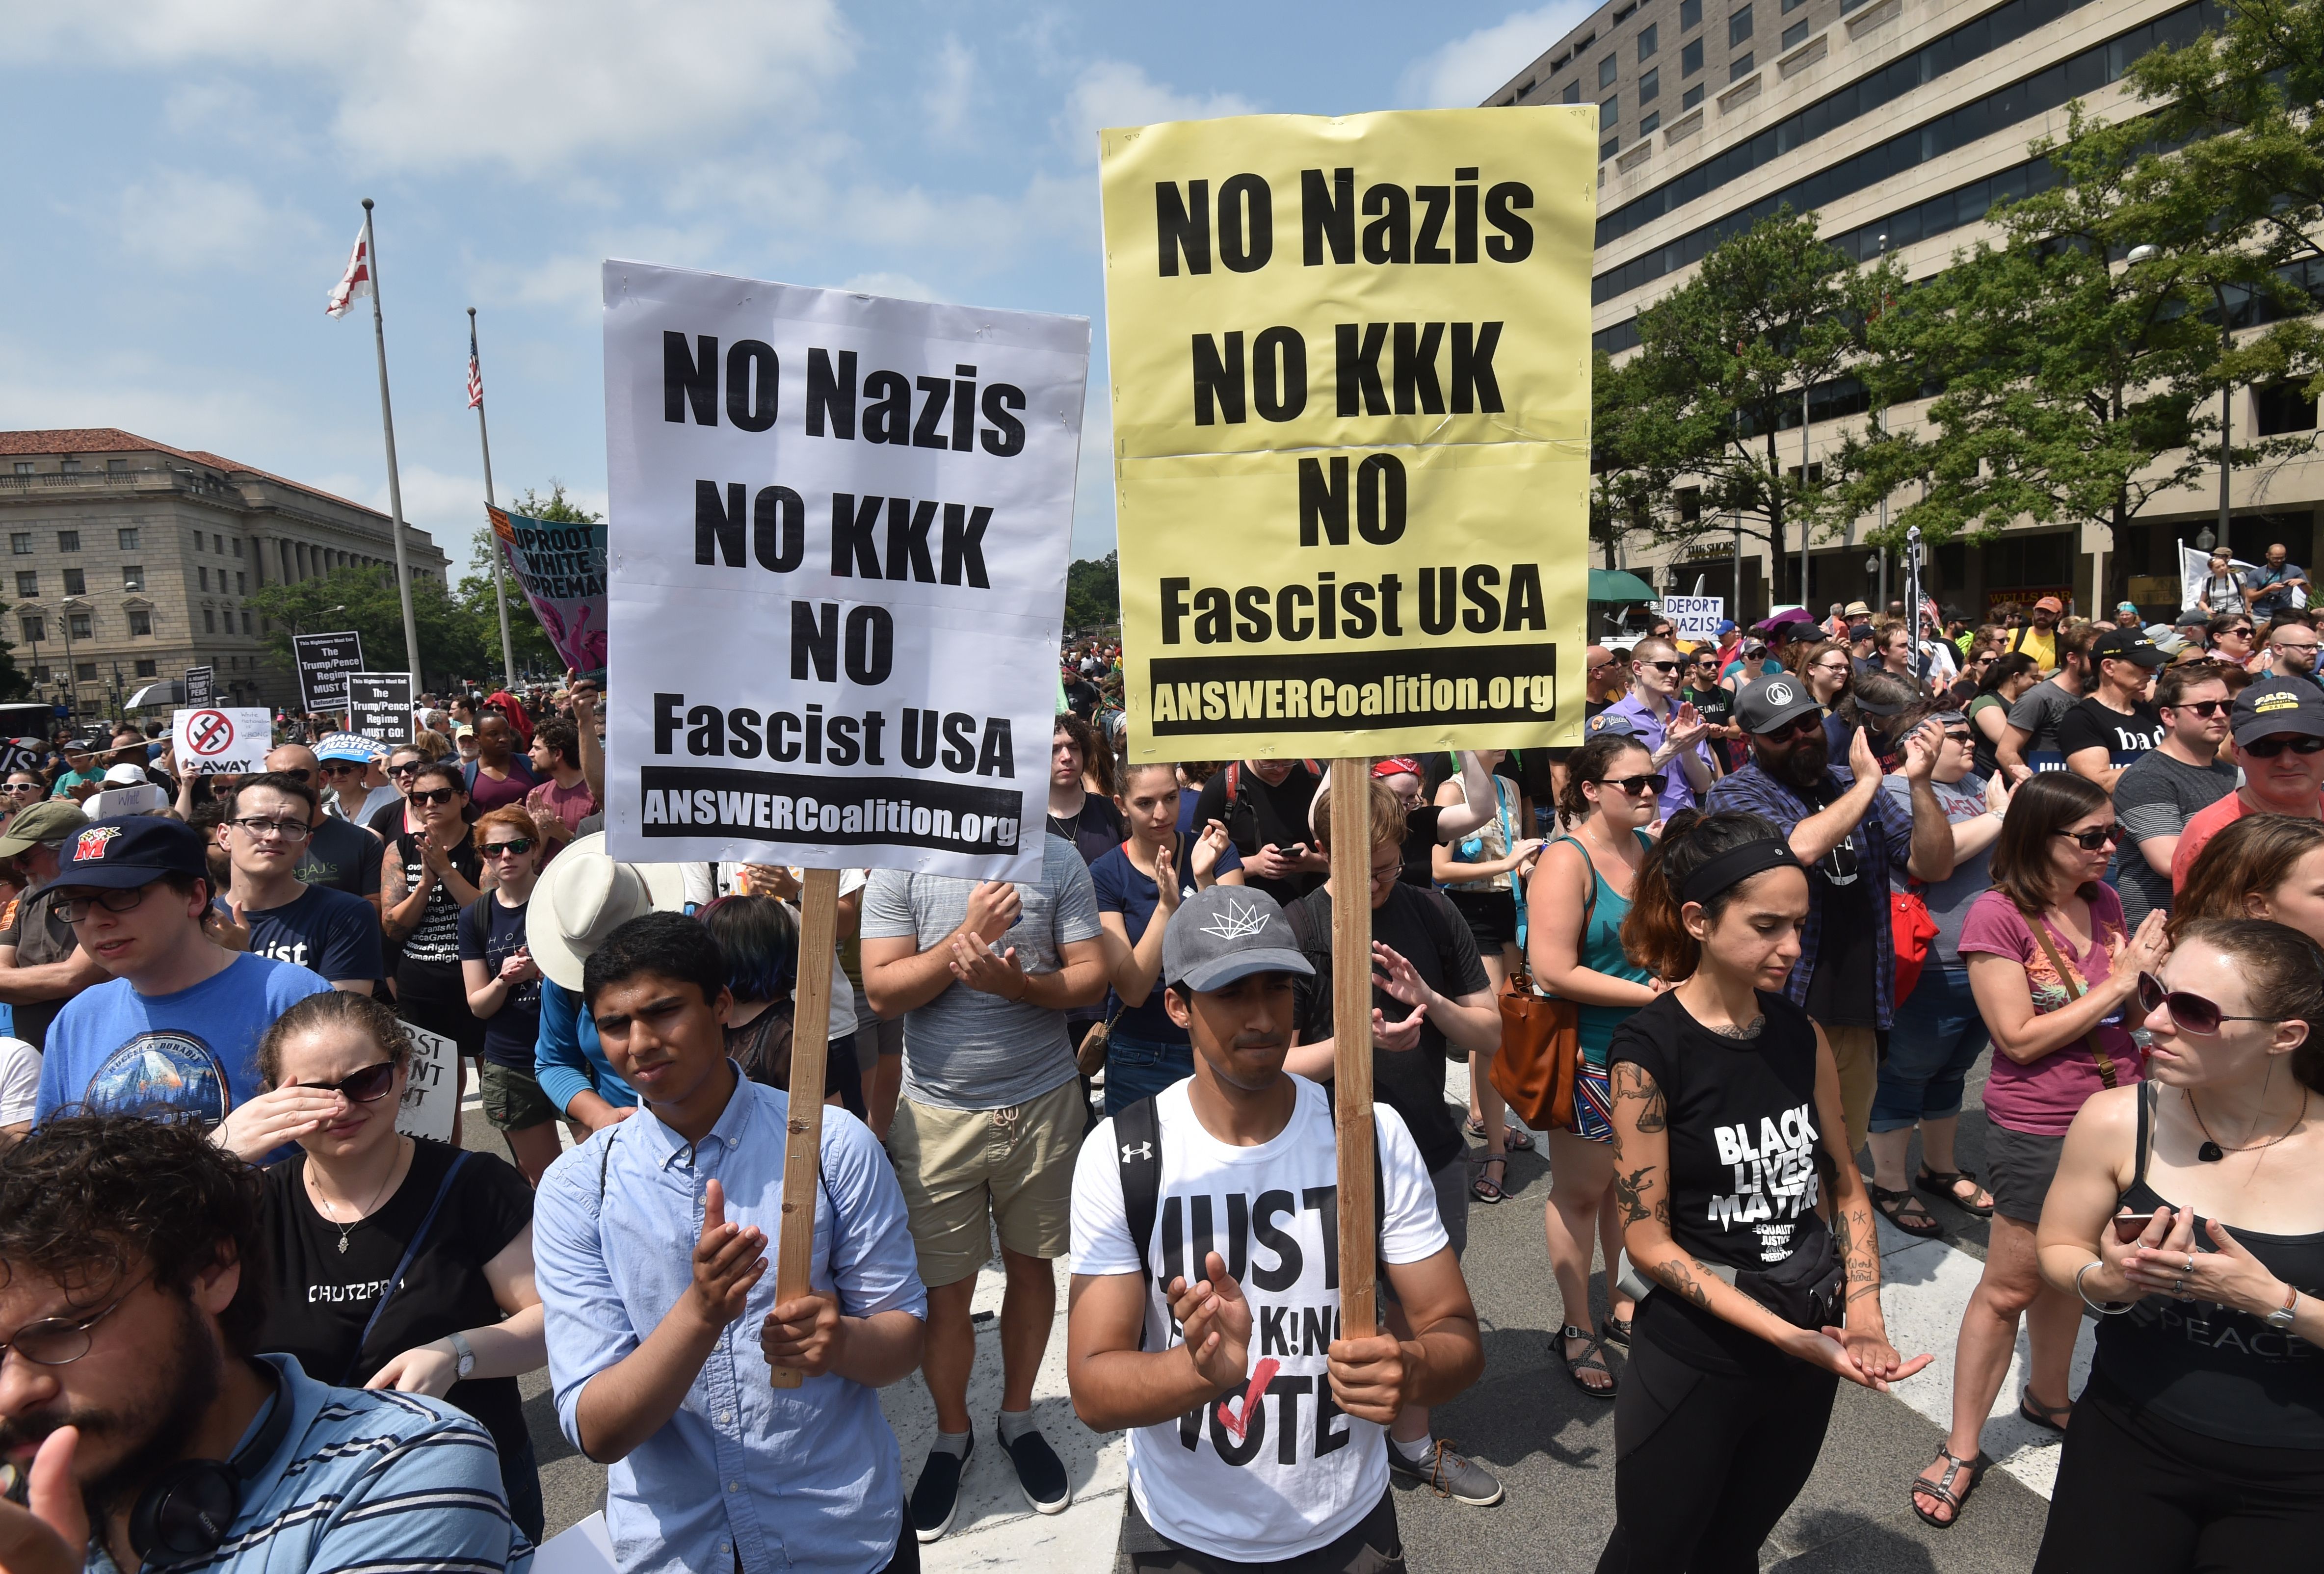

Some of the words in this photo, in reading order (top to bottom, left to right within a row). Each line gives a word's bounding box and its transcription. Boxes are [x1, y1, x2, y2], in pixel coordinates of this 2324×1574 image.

[1156, 173, 1273, 277] NO
[1301, 167, 1534, 266] Nazis
[1191, 326, 1307, 426] NO
[1335, 321, 1505, 418] KKK
[663, 330, 780, 432] NO
[805, 347, 1027, 457] Nazis
[1298, 453, 1406, 547] NO
[511, 525, 595, 551] UPROOT
[695, 479, 805, 573] NO
[831, 492, 994, 589] KKK
[524, 551, 590, 575] WHITE
[518, 572, 607, 598] UPREMA
[1990, 592, 2038, 603] WELLS
[2042, 591, 2072, 601] FAR
[1160, 572, 1402, 645] Fascist
[1418, 563, 1547, 636] USA
[1667, 599, 1719, 613] DEPORT
[321, 648, 339, 656] The
[790, 601, 894, 686] NO
[302, 658, 360, 670] Trump/Pence
[317, 670, 349, 681] Regime
[587, 669, 607, 678] MILLIO
[313, 682, 340, 694] MUST
[372, 688, 389, 698] The
[1153, 673, 1554, 723] ANSWERCoalition.org
[2254, 692, 2298, 706] PACE
[314, 697, 348, 706] RefuseFascis
[352, 701, 409, 712] Trump/Pence
[367, 714, 398, 725] Regime
[362, 728, 385, 737] MUST
[388, 728, 404, 737] GO!
[654, 692, 886, 766] Fascist
[901, 708, 1015, 779] USA
[200, 759, 252, 774] AWAY
[1936, 790, 1986, 817] AGLE
[643, 789, 1019, 846] ANSWERCoalition.org
[418, 923, 459, 934] grantsMa
[254, 941, 308, 966] ist
[406, 940, 459, 953] omensRights
[108, 1047, 143, 1074] RUGGED
[159, 1043, 203, 1064] DURABLE
[1714, 1103, 1819, 1165] BLACK
[1734, 1143, 1813, 1194] LIVES
[1708, 1173, 1818, 1232] MATTER
[1157, 1184, 1339, 1294] JUST
[1847, 1258, 1875, 1270] Work
[1847, 1270, 1874, 1283] hard
[2160, 1307, 2311, 1358] PEACE
[1179, 1374, 1350, 1466] VOTE
[199, 1512, 218, 1534] SONY
